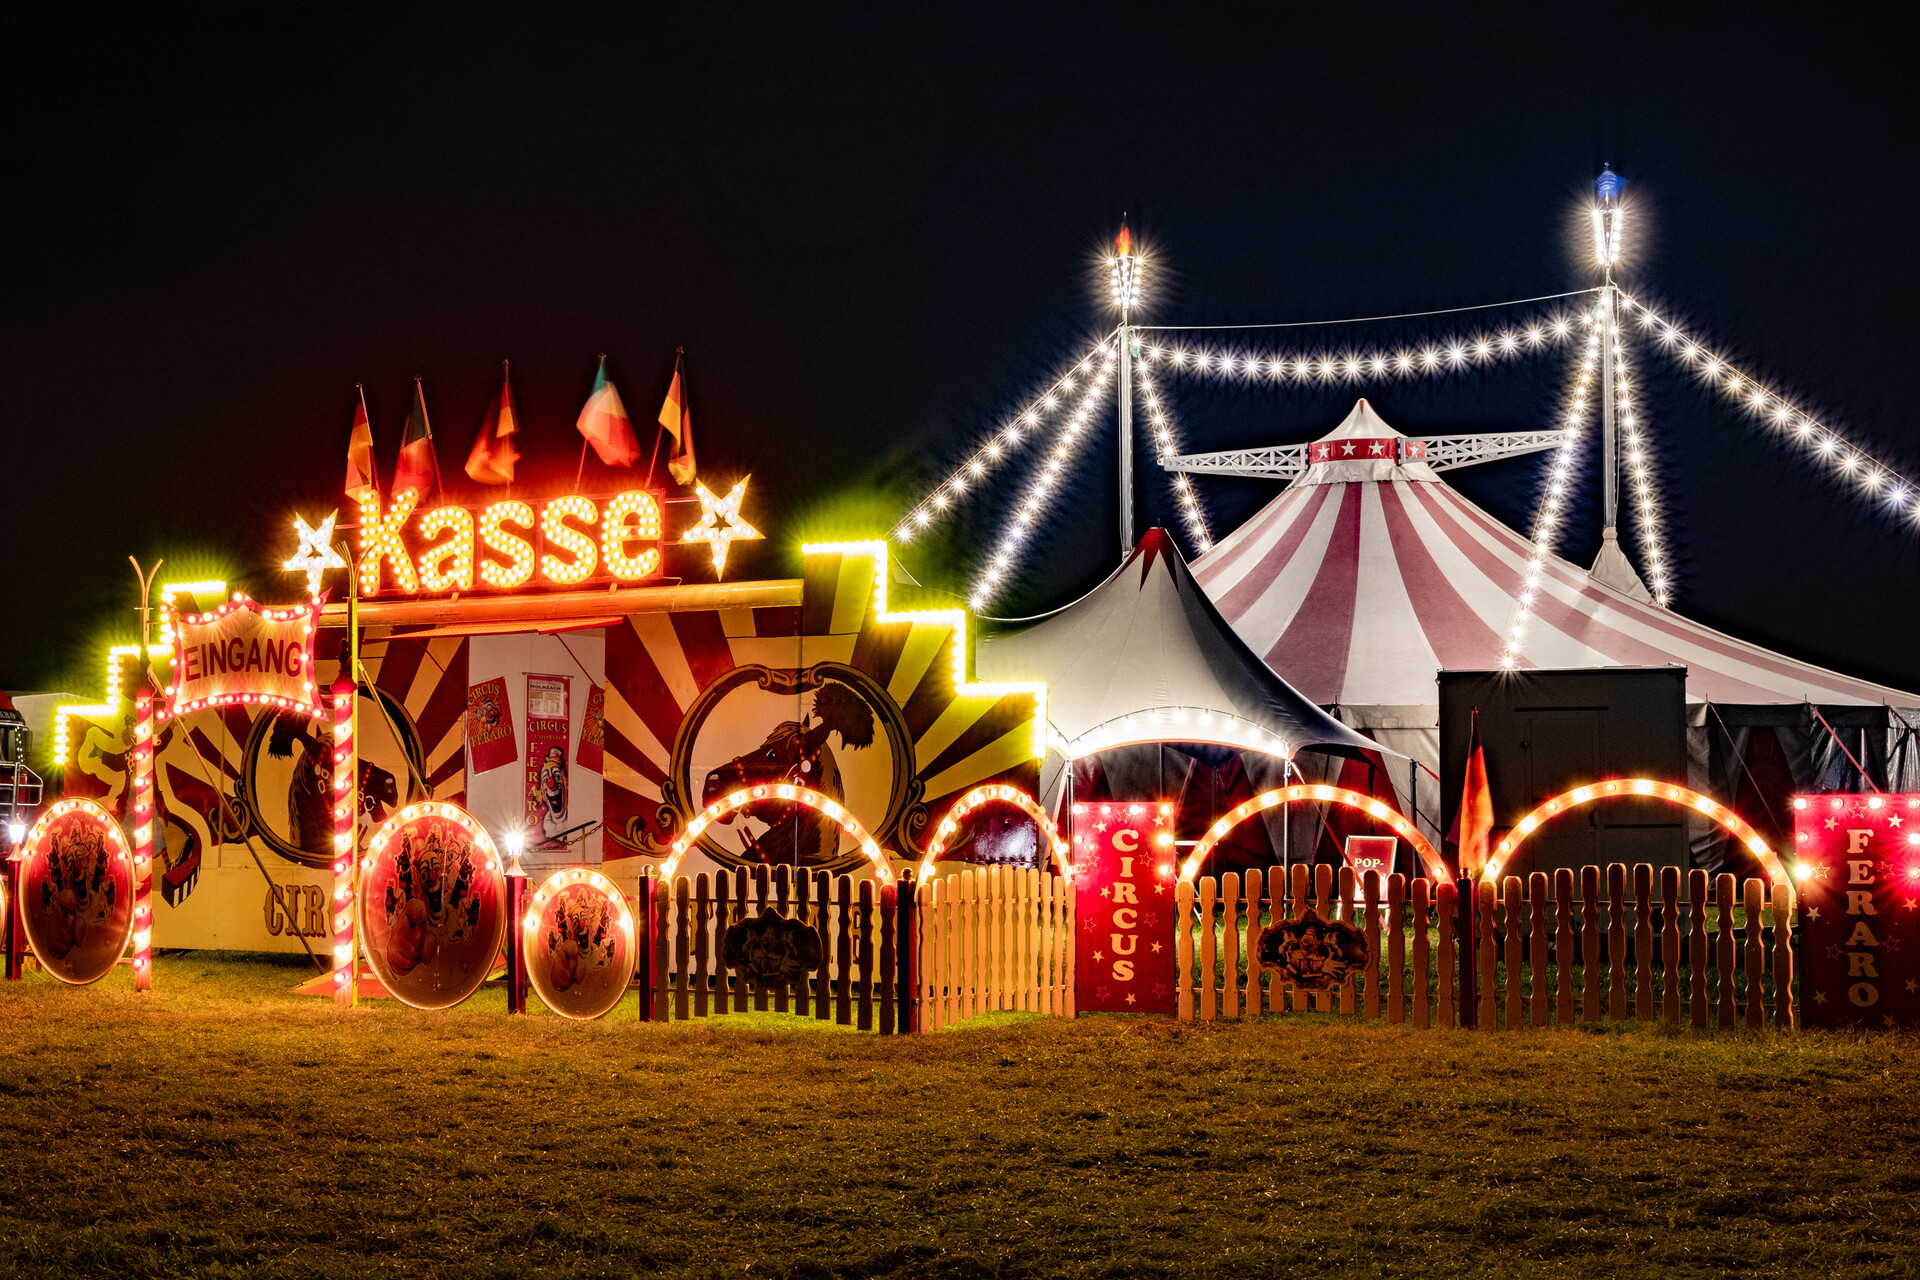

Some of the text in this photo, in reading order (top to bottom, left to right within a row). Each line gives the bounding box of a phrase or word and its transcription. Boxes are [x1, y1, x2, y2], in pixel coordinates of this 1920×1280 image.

[183, 637, 303, 682] EINGANG
[468, 683, 500, 706] CIRCUS
[471, 724, 512, 747] FERARO
[529, 720, 567, 733] CIRCUS
[526, 742, 539, 826] FERARO
[1354, 857, 1384, 868] POP-
[263, 884, 335, 938] CIR
[1110, 829, 1140, 982] CIRCUS
[1845, 829, 1880, 1007] FERARO
